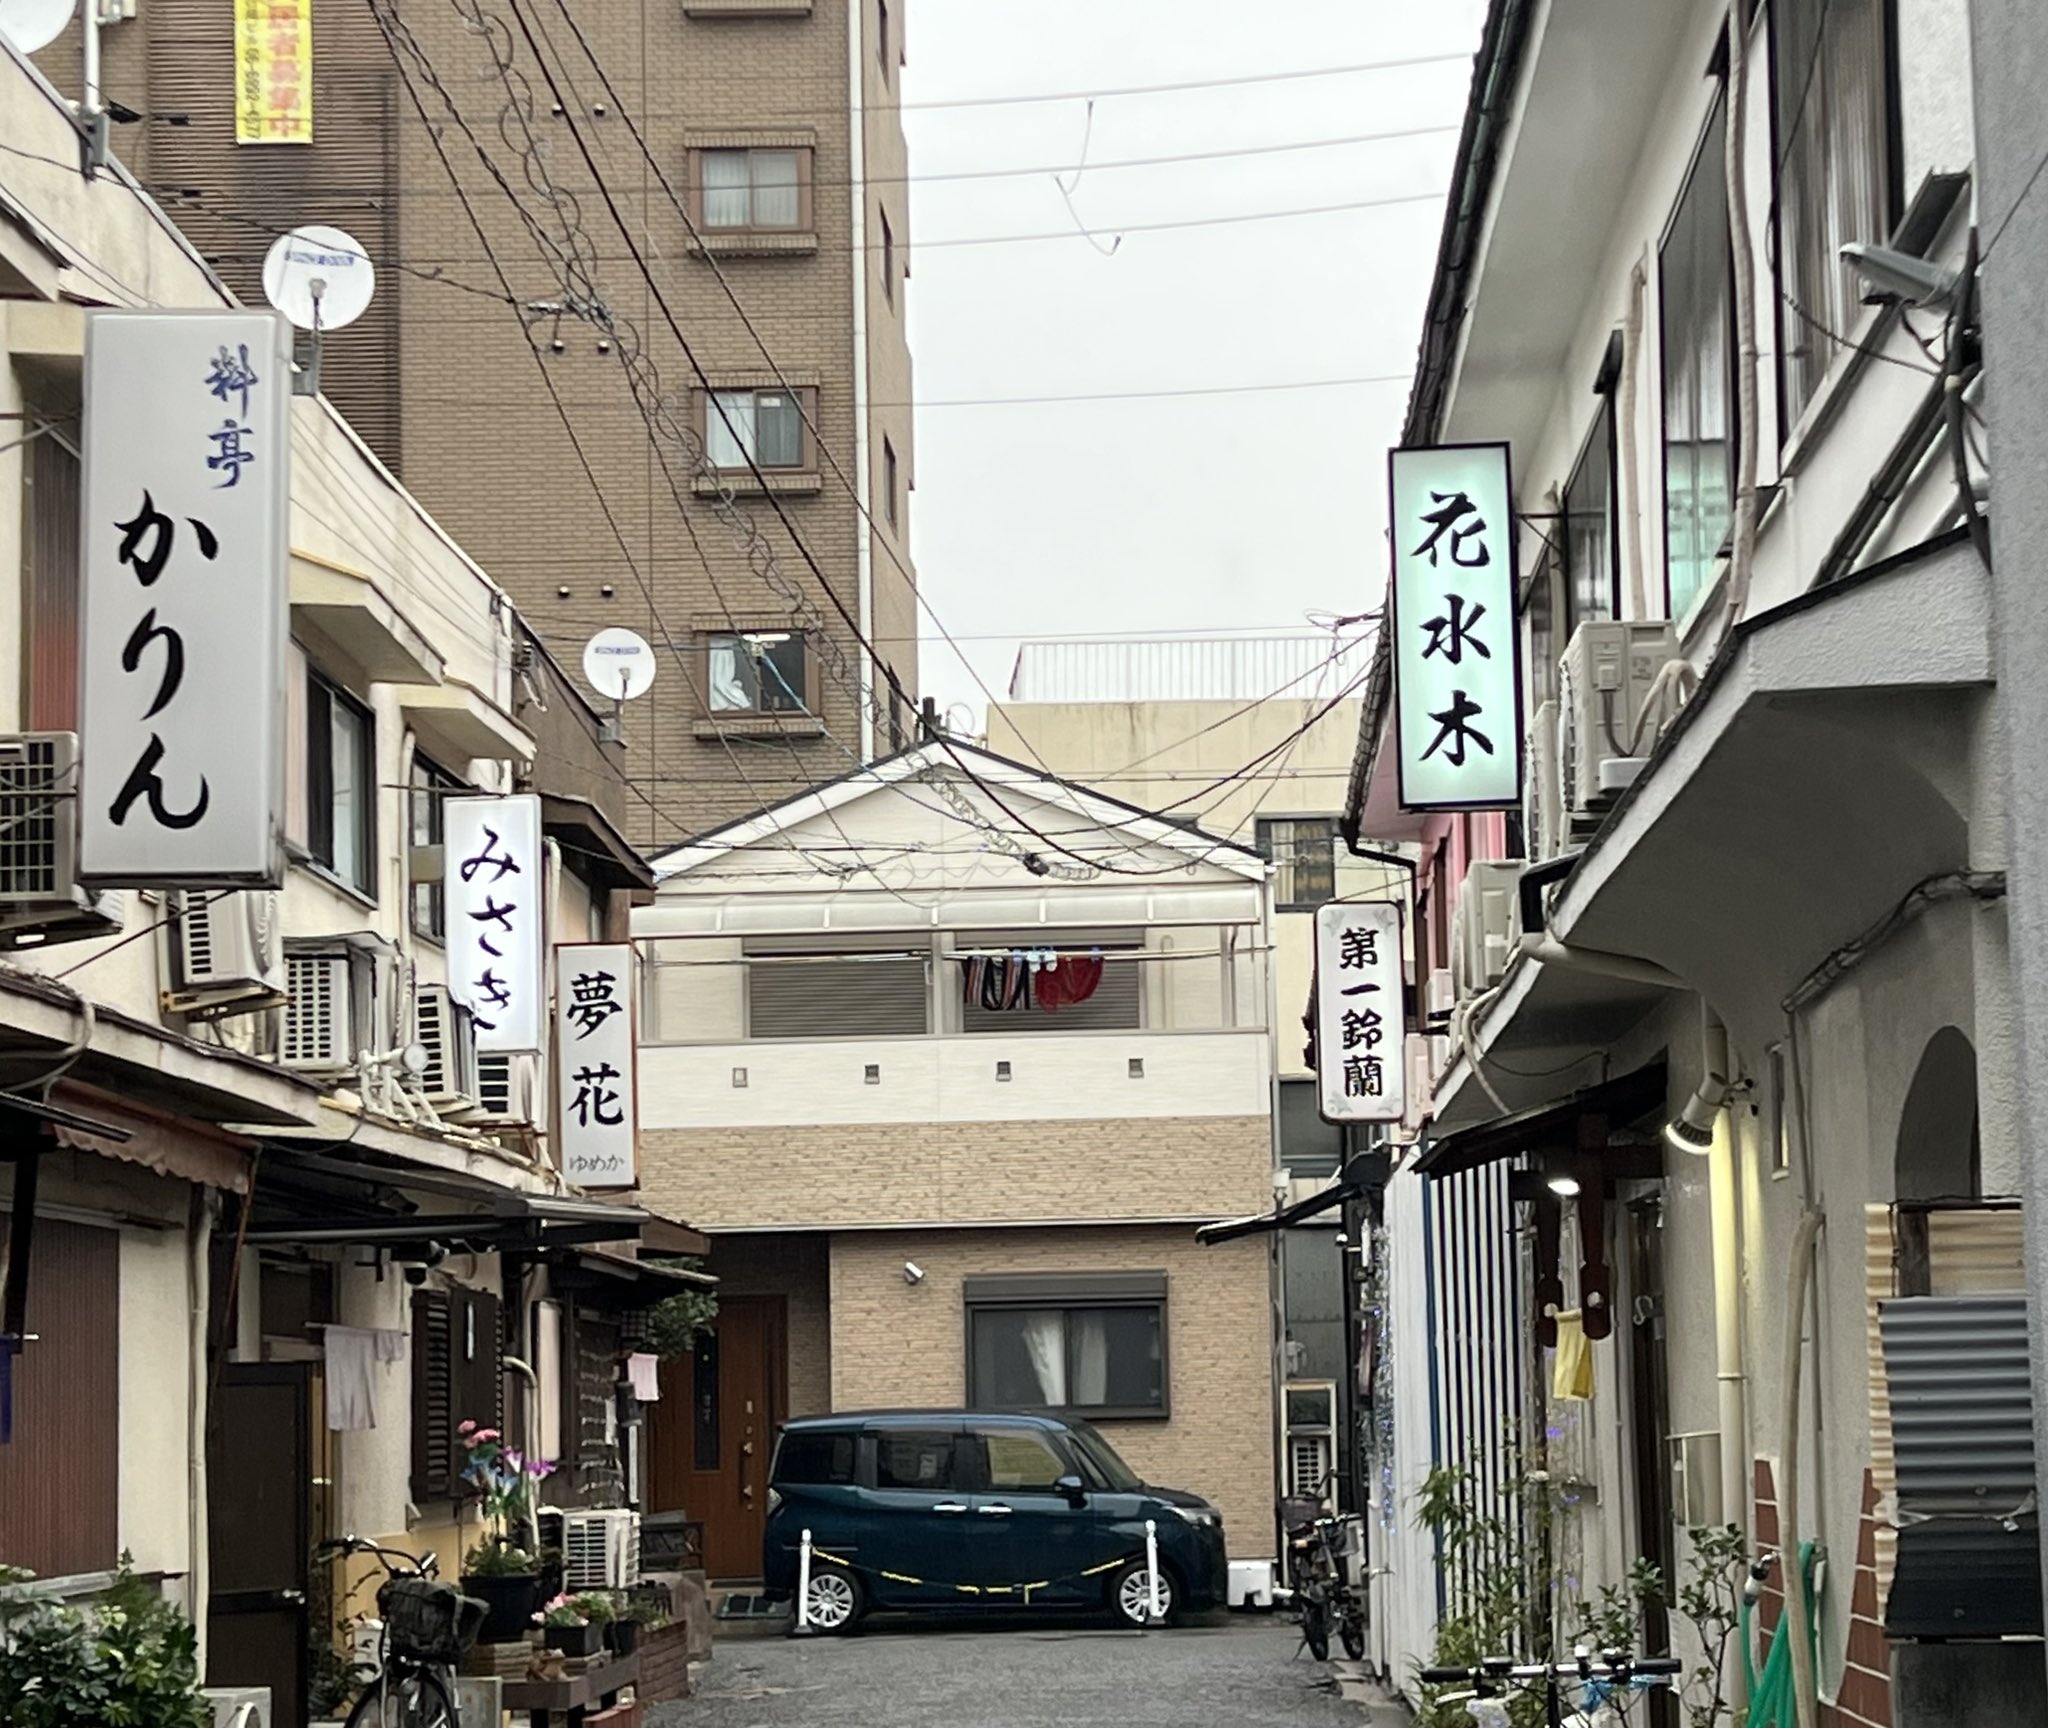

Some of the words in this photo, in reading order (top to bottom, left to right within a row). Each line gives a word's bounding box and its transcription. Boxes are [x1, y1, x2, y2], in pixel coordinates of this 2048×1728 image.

[267, 0, 301, 137] 居者募集中
[205, 343, 258, 489] 料亭
[108, 488, 219, 830] かりん
[1409, 490, 1494, 767] 花水木
[460, 824, 521, 1031] みさき
[566, 970, 624, 1128] 夢花
[1339, 926, 1384, 1098] 第一鈴蘭
[569, 1154, 625, 1173] ゆめか
